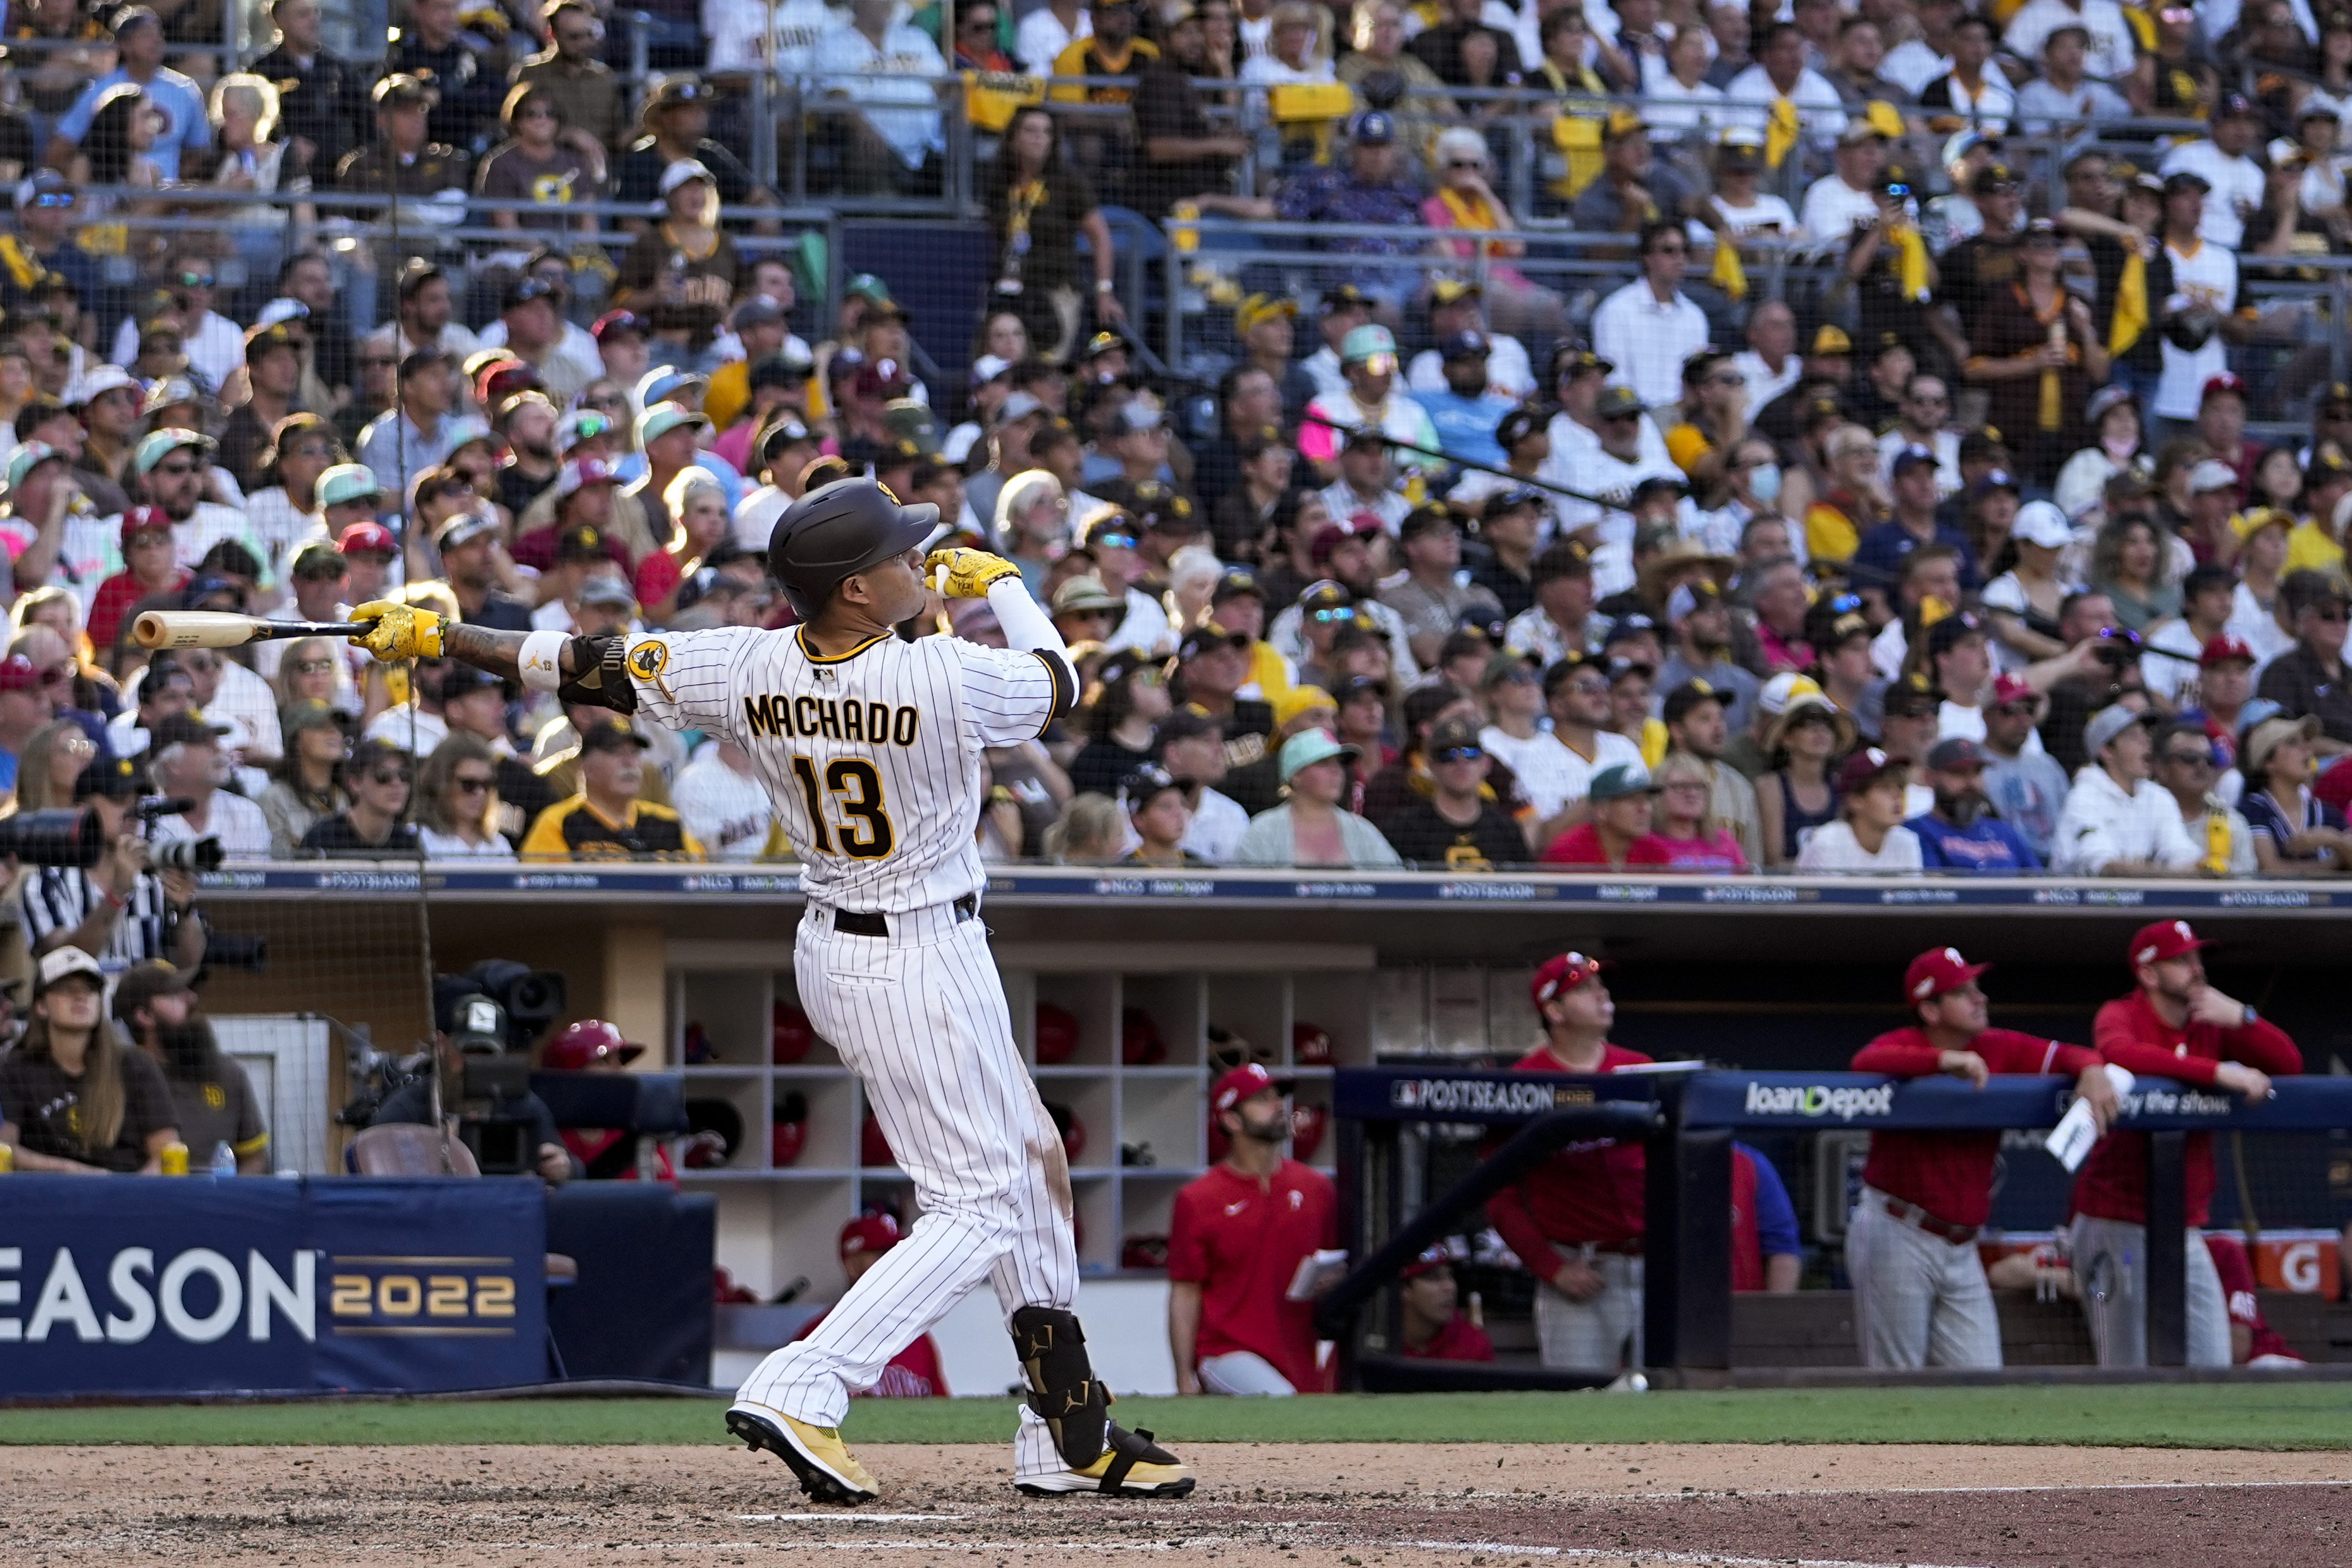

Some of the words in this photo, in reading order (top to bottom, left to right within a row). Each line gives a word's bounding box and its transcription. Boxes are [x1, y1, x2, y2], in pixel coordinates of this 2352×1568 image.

[744, 694, 918, 747] MACHADO
[792, 755, 896, 861] 13
[1417, 1079, 1555, 1114] POSTSEASON
[1745, 1081, 1895, 1122] loanDepot
[2281, 1242, 2320, 1293] G
[331, 1275, 516, 1317] 2022
